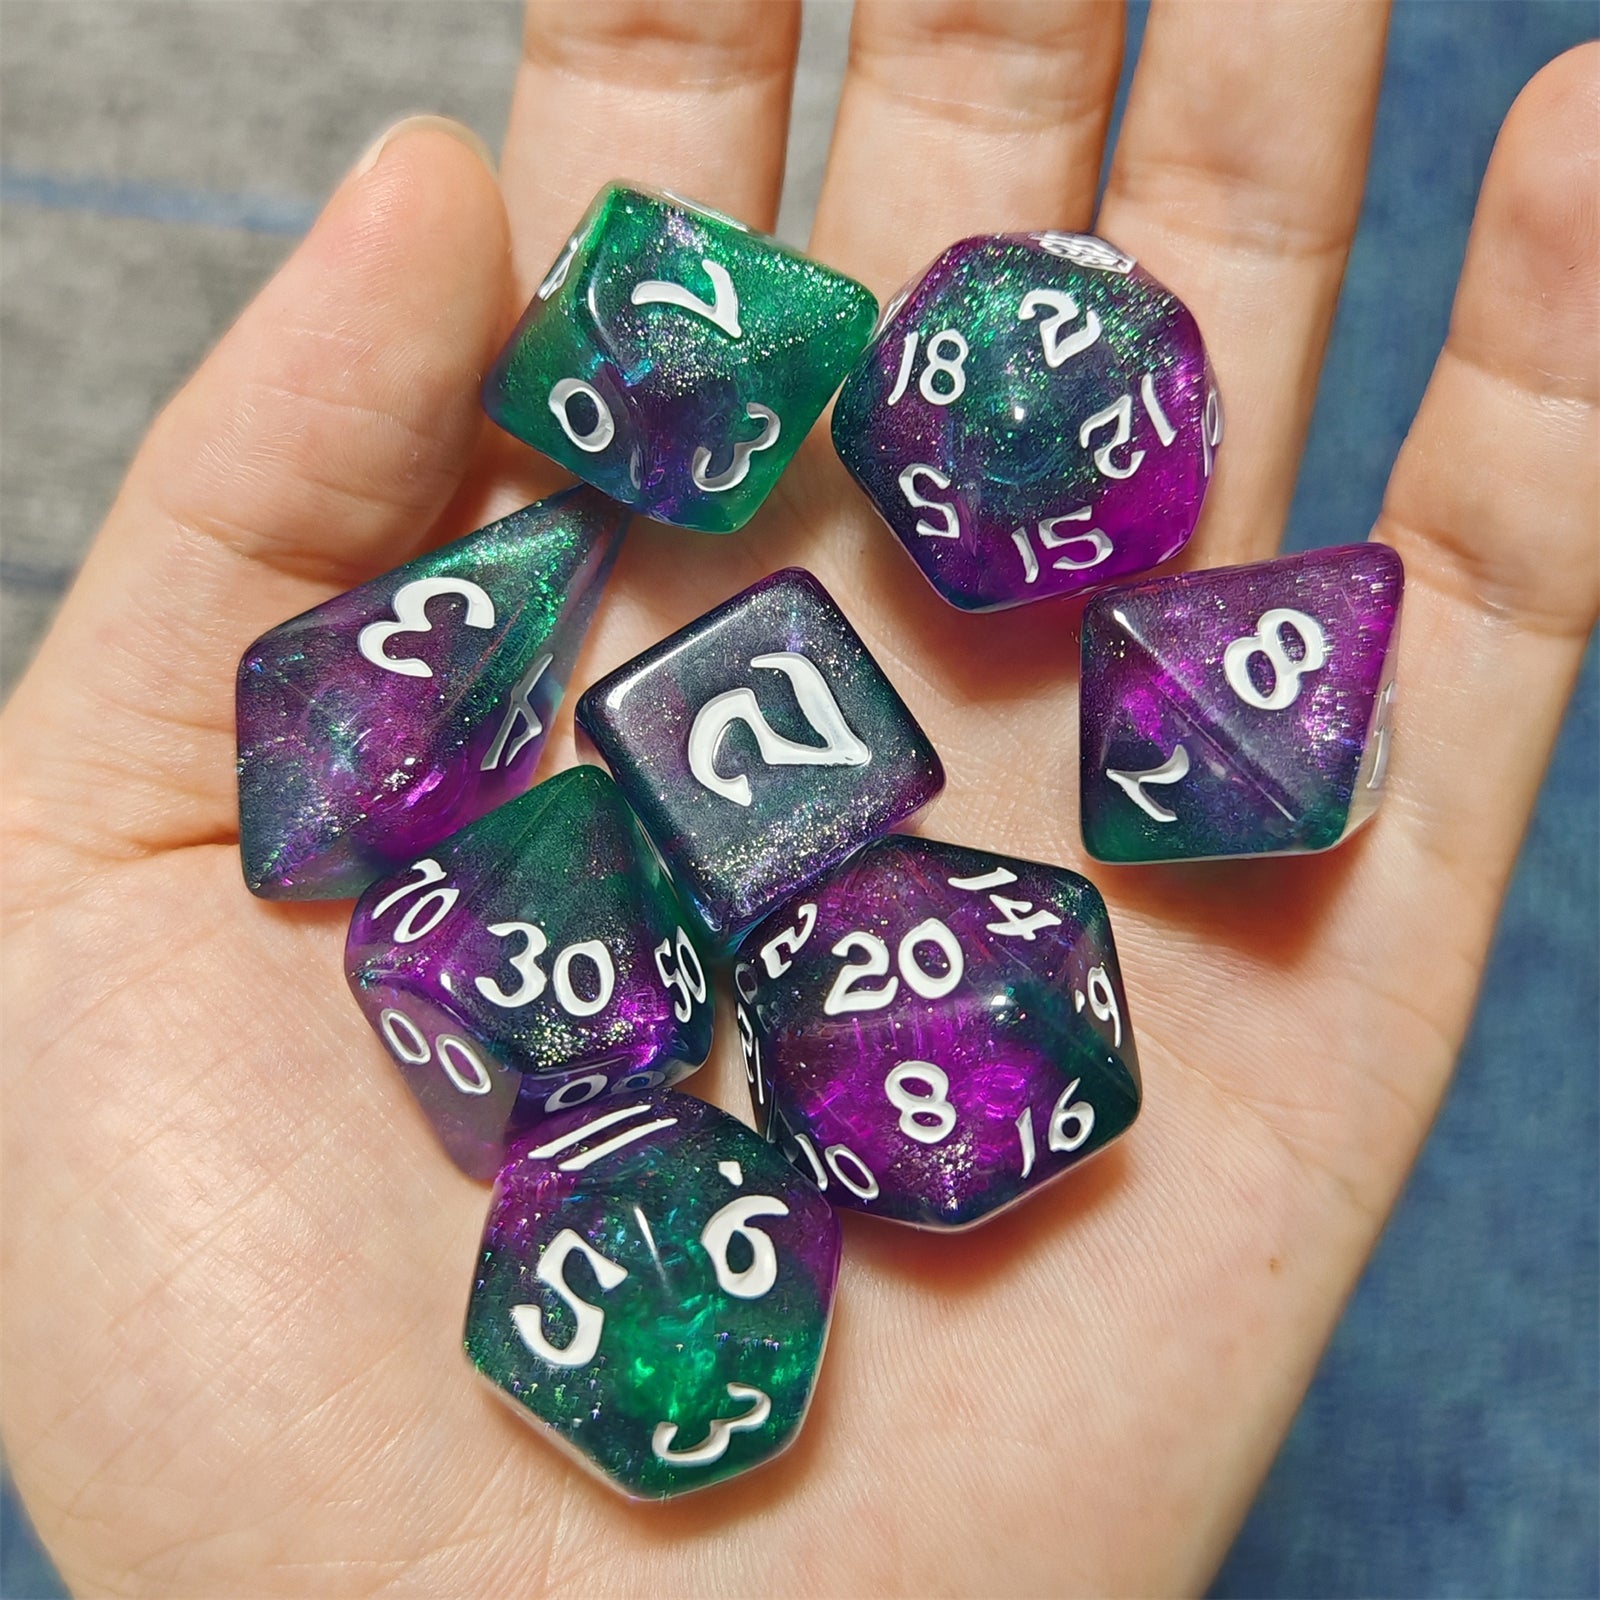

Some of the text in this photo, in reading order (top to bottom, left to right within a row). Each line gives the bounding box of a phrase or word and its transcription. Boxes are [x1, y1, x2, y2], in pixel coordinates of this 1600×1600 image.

[630, 259, 742, 339] 7
[1018, 288, 1102, 368] 2
[887, 328, 969, 406] 18
[547, 377, 615, 453] 0
[692, 402, 781, 492] 3
[1079, 372, 1178, 480] 12
[898, 462, 961, 539] 5
[1011, 505, 1113, 583] 15
[357, 576, 496, 678] 3
[1223, 608, 1327, 710] 8
[688, 652, 872, 807] 2
[760, 903, 818, 980] 2
[947, 867, 1063, 941] 14
[474, 921, 616, 1017] 30
[654, 926, 707, 1024] 50
[824, 917, 964, 1016] 20
[381, 1007, 492, 1095] 00
[884, 1060, 957, 1144] 8
[1014, 1077, 1096, 1180] 16
[794, 1132, 880, 1201] 10
[511, 1228, 629, 1368] 5
[651, 1382, 773, 1467] 3
